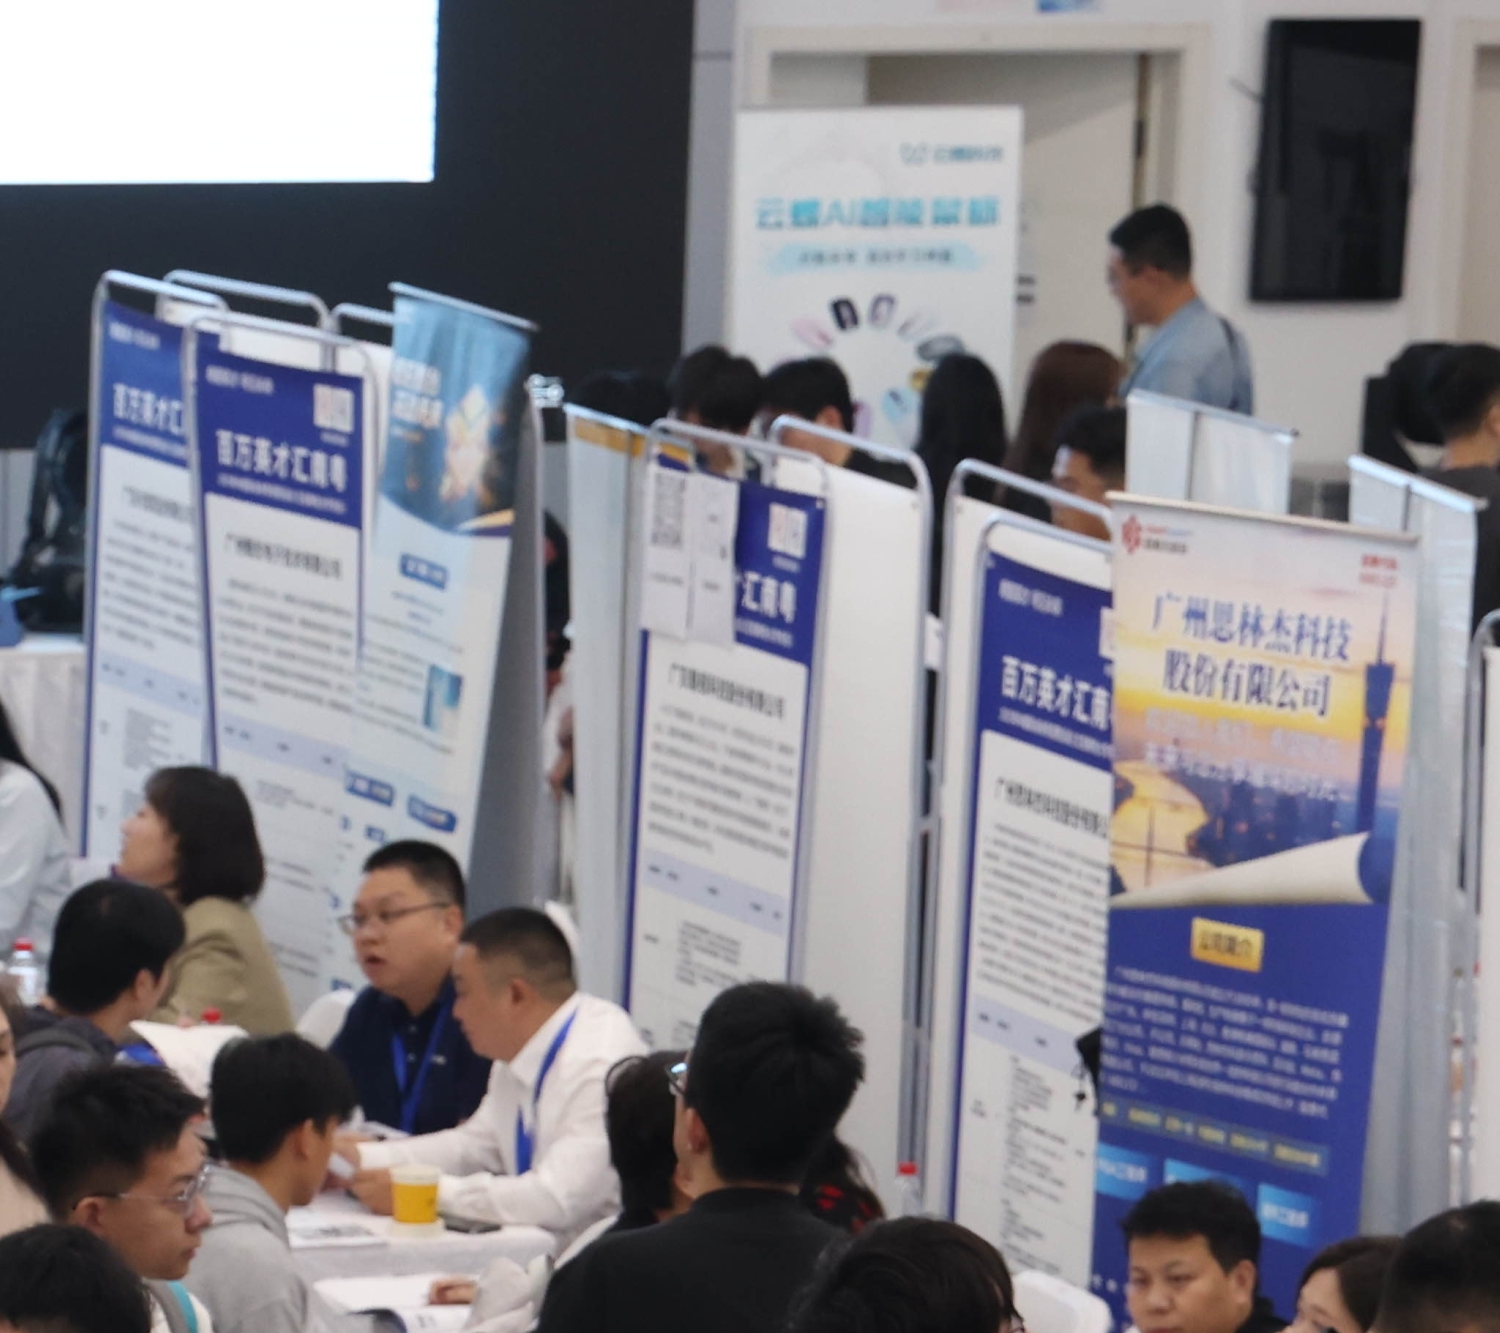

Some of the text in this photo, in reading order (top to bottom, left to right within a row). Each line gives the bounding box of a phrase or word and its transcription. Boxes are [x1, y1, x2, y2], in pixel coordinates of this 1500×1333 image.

[1152, 591, 1354, 664] 广州思林杰科技
[1162, 648, 1332, 718] 股份有限公司
